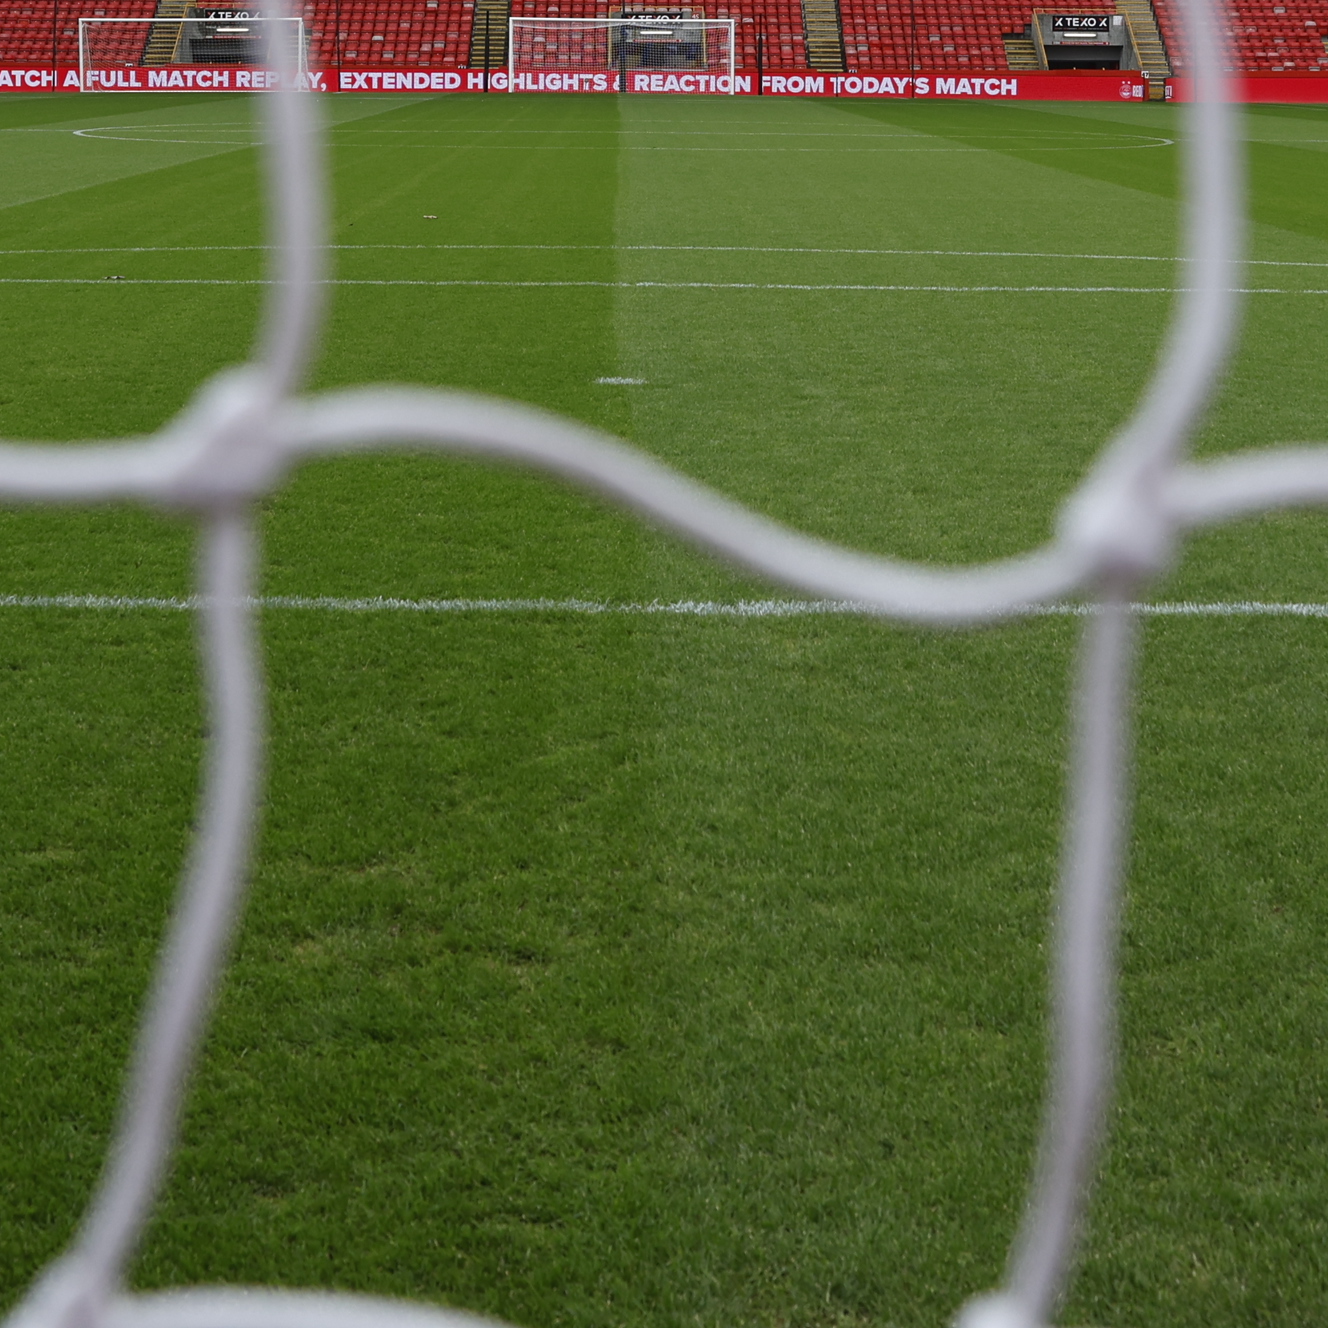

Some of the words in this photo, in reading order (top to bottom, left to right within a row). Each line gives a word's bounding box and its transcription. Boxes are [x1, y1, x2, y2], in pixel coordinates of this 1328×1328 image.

[1065, 17, 1097, 27] TEXO
[63, 70, 81, 87] A
[86, 70, 142, 87] FULL
[147, 70, 229, 87] MATCH
[235, 70, 327, 92] REPAY,
[339, 72, 461, 89] EXTENDED
[634, 74, 751, 93] REACTION
[761, 76, 825, 93] FROM
[830, 76, 930, 95] TODAY'S
[935, 77, 1018, 96] MATCH
